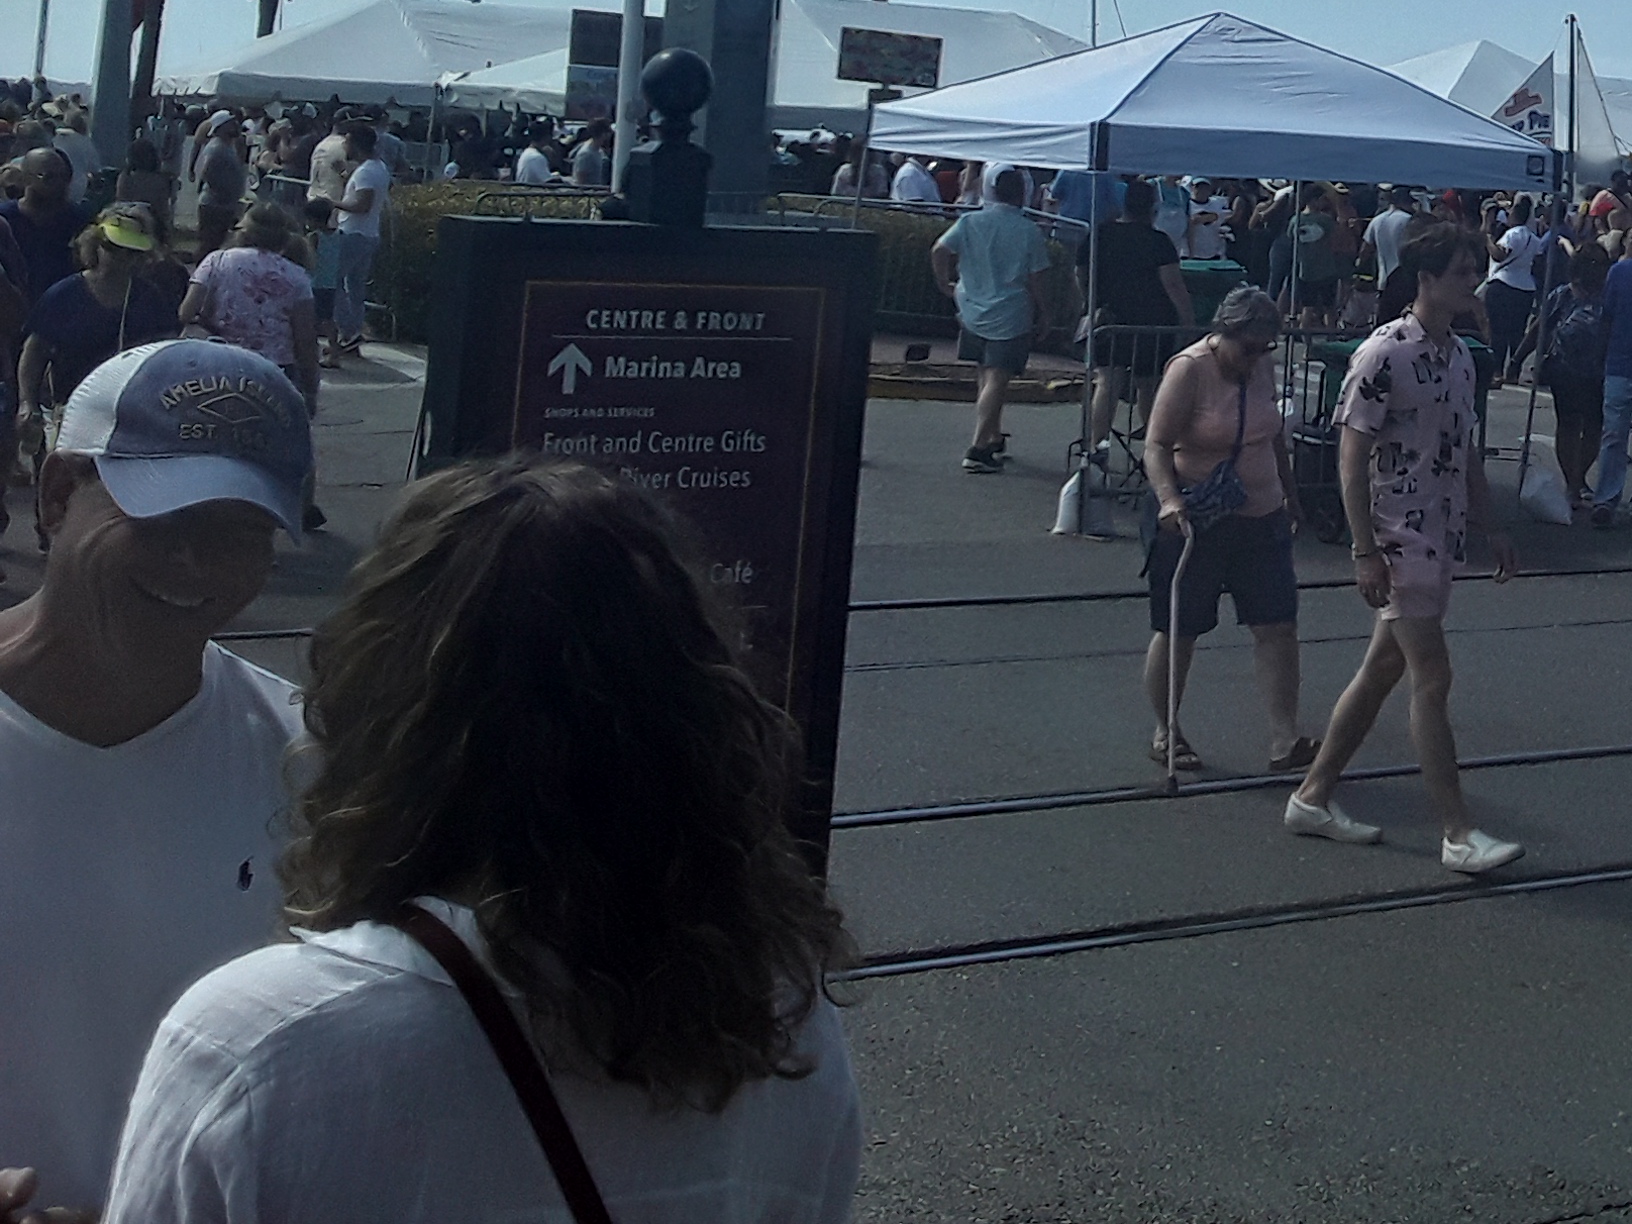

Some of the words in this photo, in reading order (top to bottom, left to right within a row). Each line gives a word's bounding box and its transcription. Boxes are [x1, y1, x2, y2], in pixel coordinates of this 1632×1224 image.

[585, 309, 667, 330] CENTRE
[673, 310, 688, 330] &
[695, 311, 767, 332] FRONT
[604, 355, 685, 379] Marina
[690, 356, 742, 379] Area
[543, 407, 579, 418] SHOPS
[582, 407, 605, 417] AND
[607, 406, 655, 418] SERVICES
[542, 432, 599, 455] Front
[602, 431, 641, 454] and
[647, 431, 714, 455] Centre
[721, 429, 767, 454] Gifts
[677, 466, 752, 489] Cruises
[710, 559, 755, 585] Café
